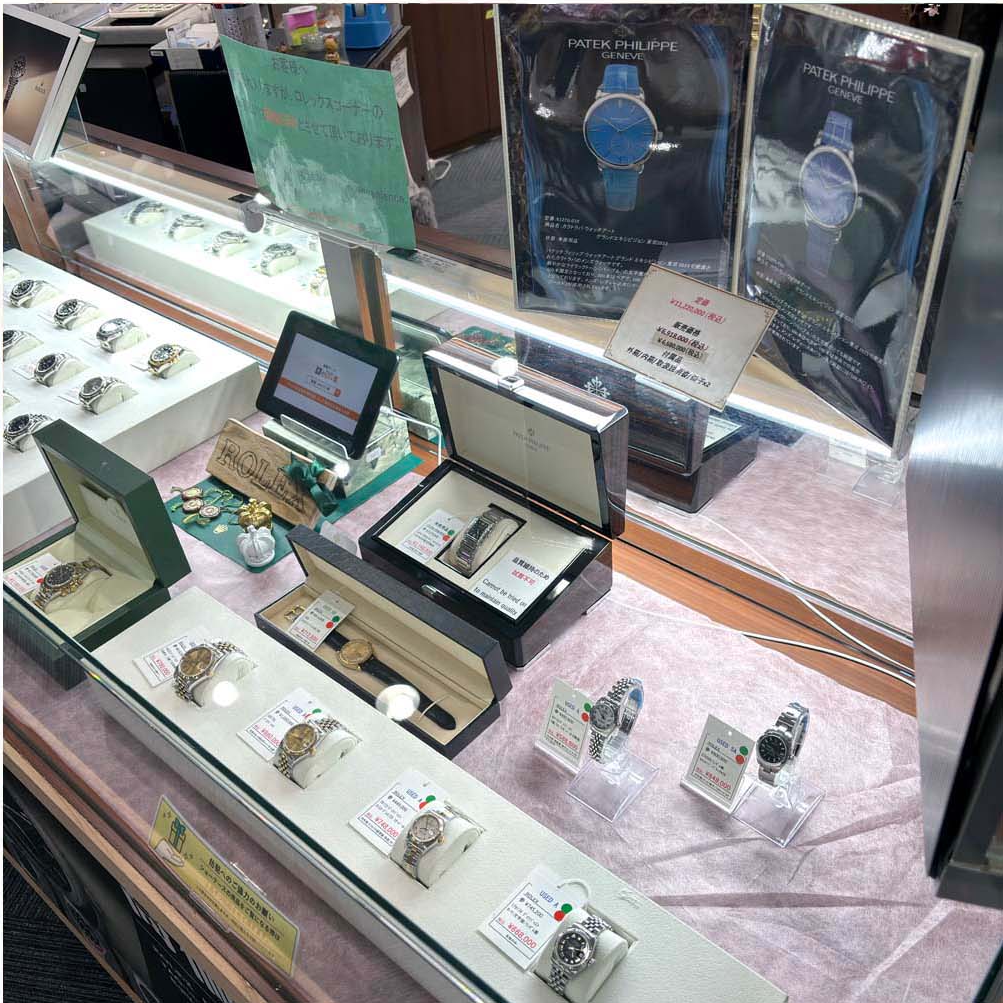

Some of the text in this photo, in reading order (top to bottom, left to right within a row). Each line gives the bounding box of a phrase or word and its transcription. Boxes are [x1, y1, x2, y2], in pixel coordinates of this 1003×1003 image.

[568, 38, 678, 52] PATEK PHILIPPE
[601, 51, 644, 60] GENEVE
[803, 62, 896, 104] PATEK PHILIPPE
[828, 85, 864, 105] GENEVE
[482, 578, 500, 594] Cannot
[500, 587, 508, 596] be
[508, 590, 520, 602] tried
[480, 590, 500, 606] maintain
[501, 602, 518, 616] quality
[539, 890, 554, 903] USED
